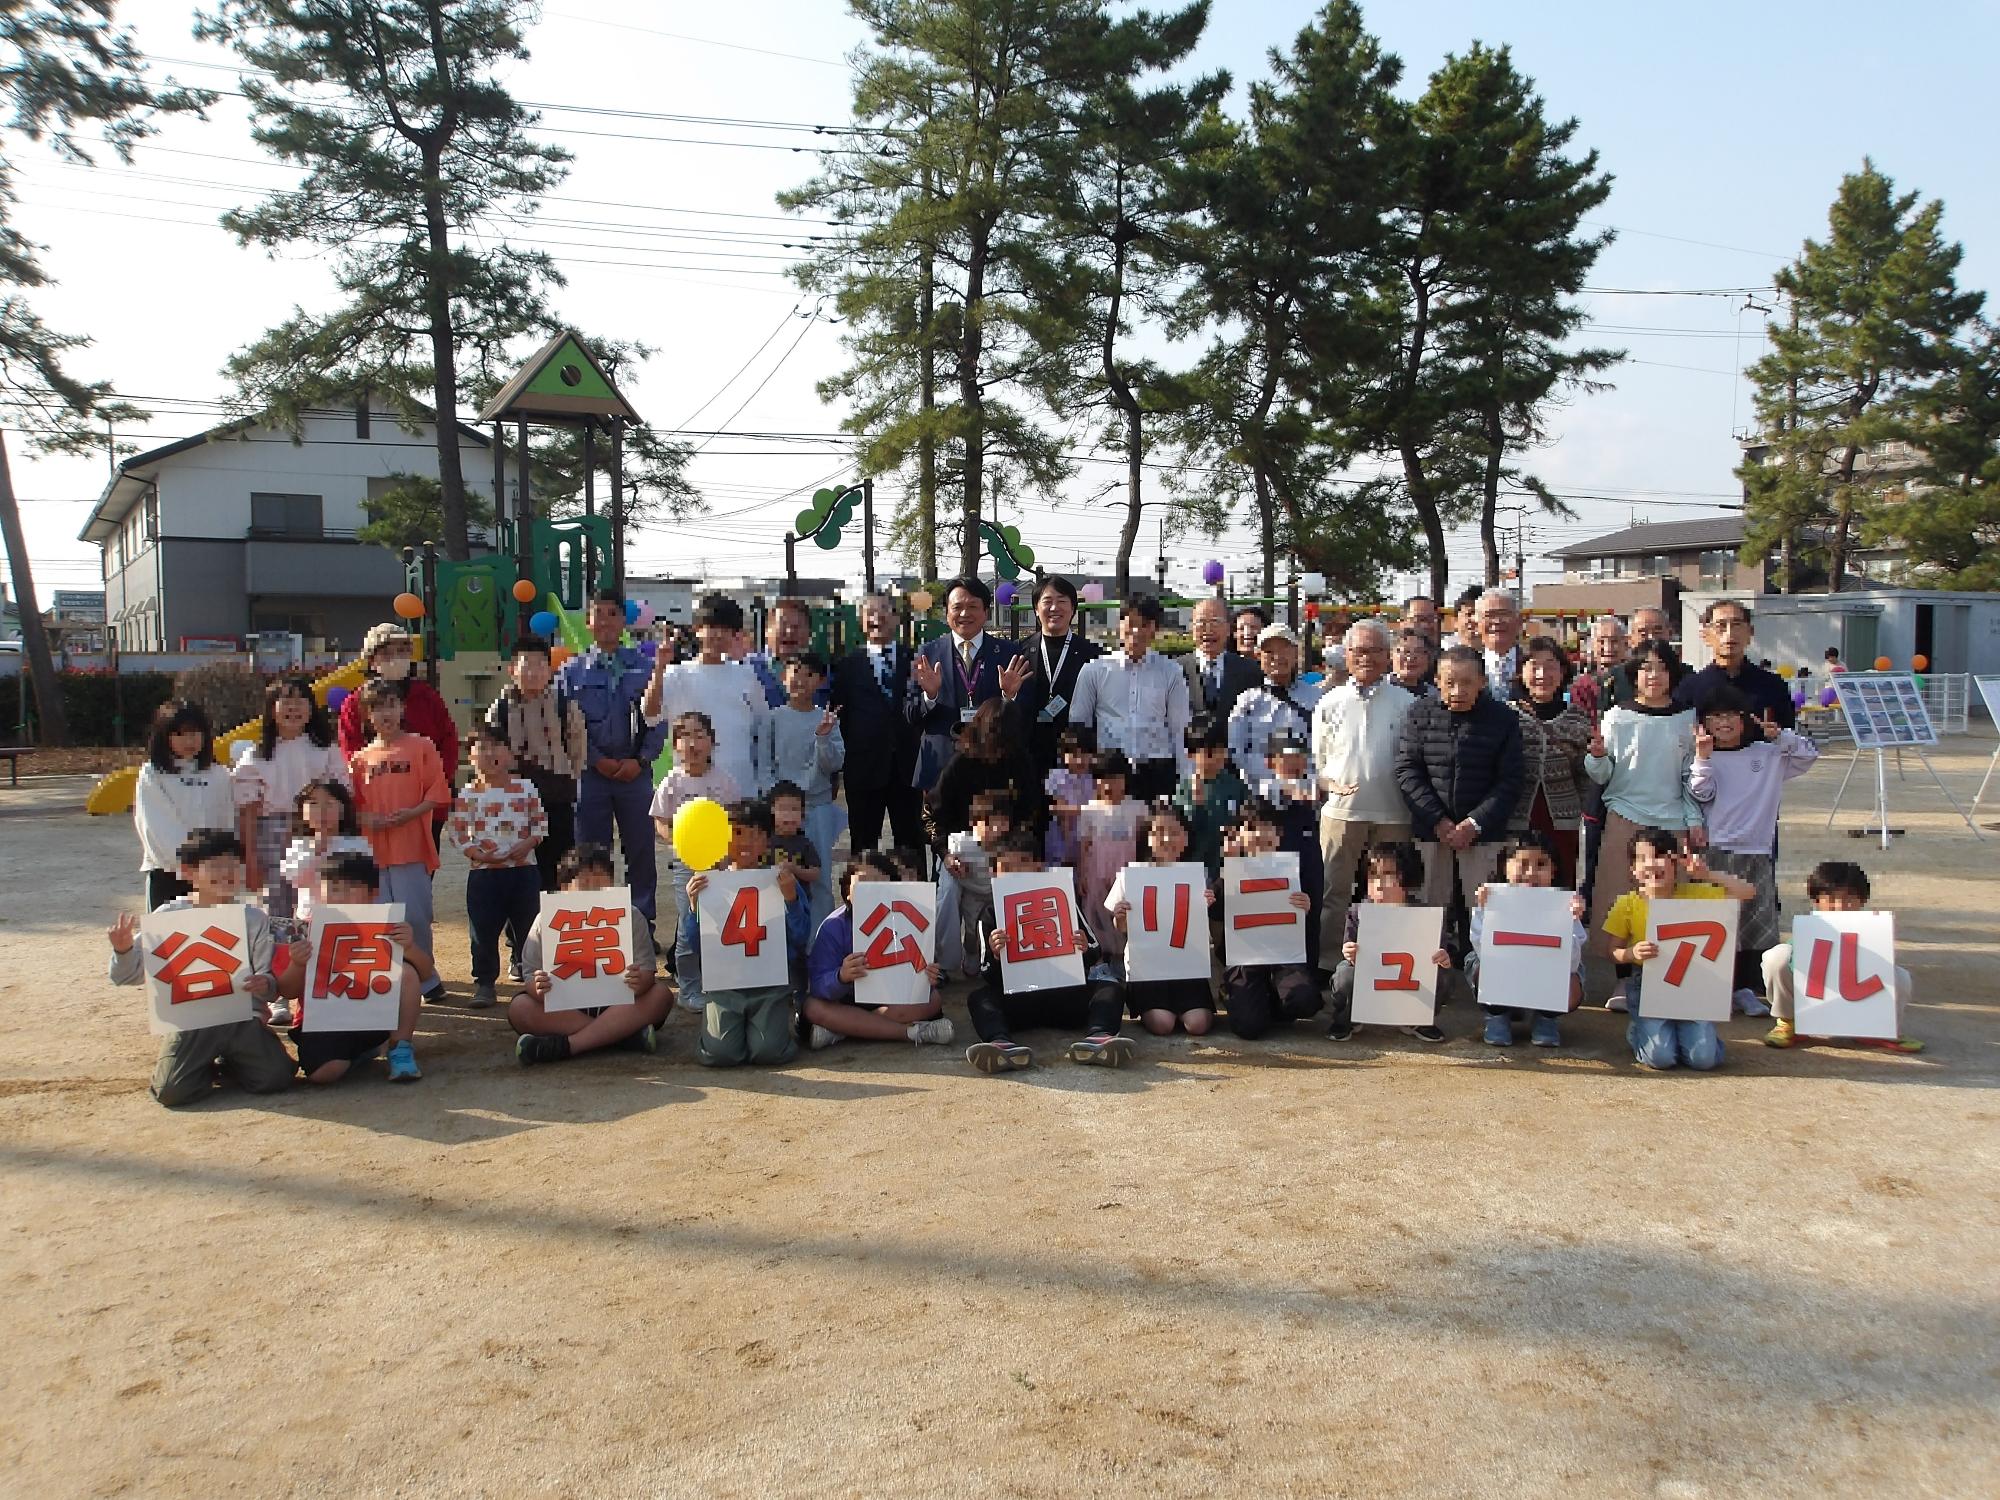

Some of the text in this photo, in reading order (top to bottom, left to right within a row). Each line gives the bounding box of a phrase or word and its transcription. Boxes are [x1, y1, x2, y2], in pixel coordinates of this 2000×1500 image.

[549, 906, 627, 981] 第
[721, 886, 767, 958] 4
[859, 900, 930, 974] 公
[1004, 886, 1077, 963] 園
[1143, 883, 1191, 949] リ
[152, 925, 242, 1006] 谷
[312, 923, 397, 1000] 原
[1656, 920, 1728, 988] ア
[1806, 931, 1884, 1002] ル
